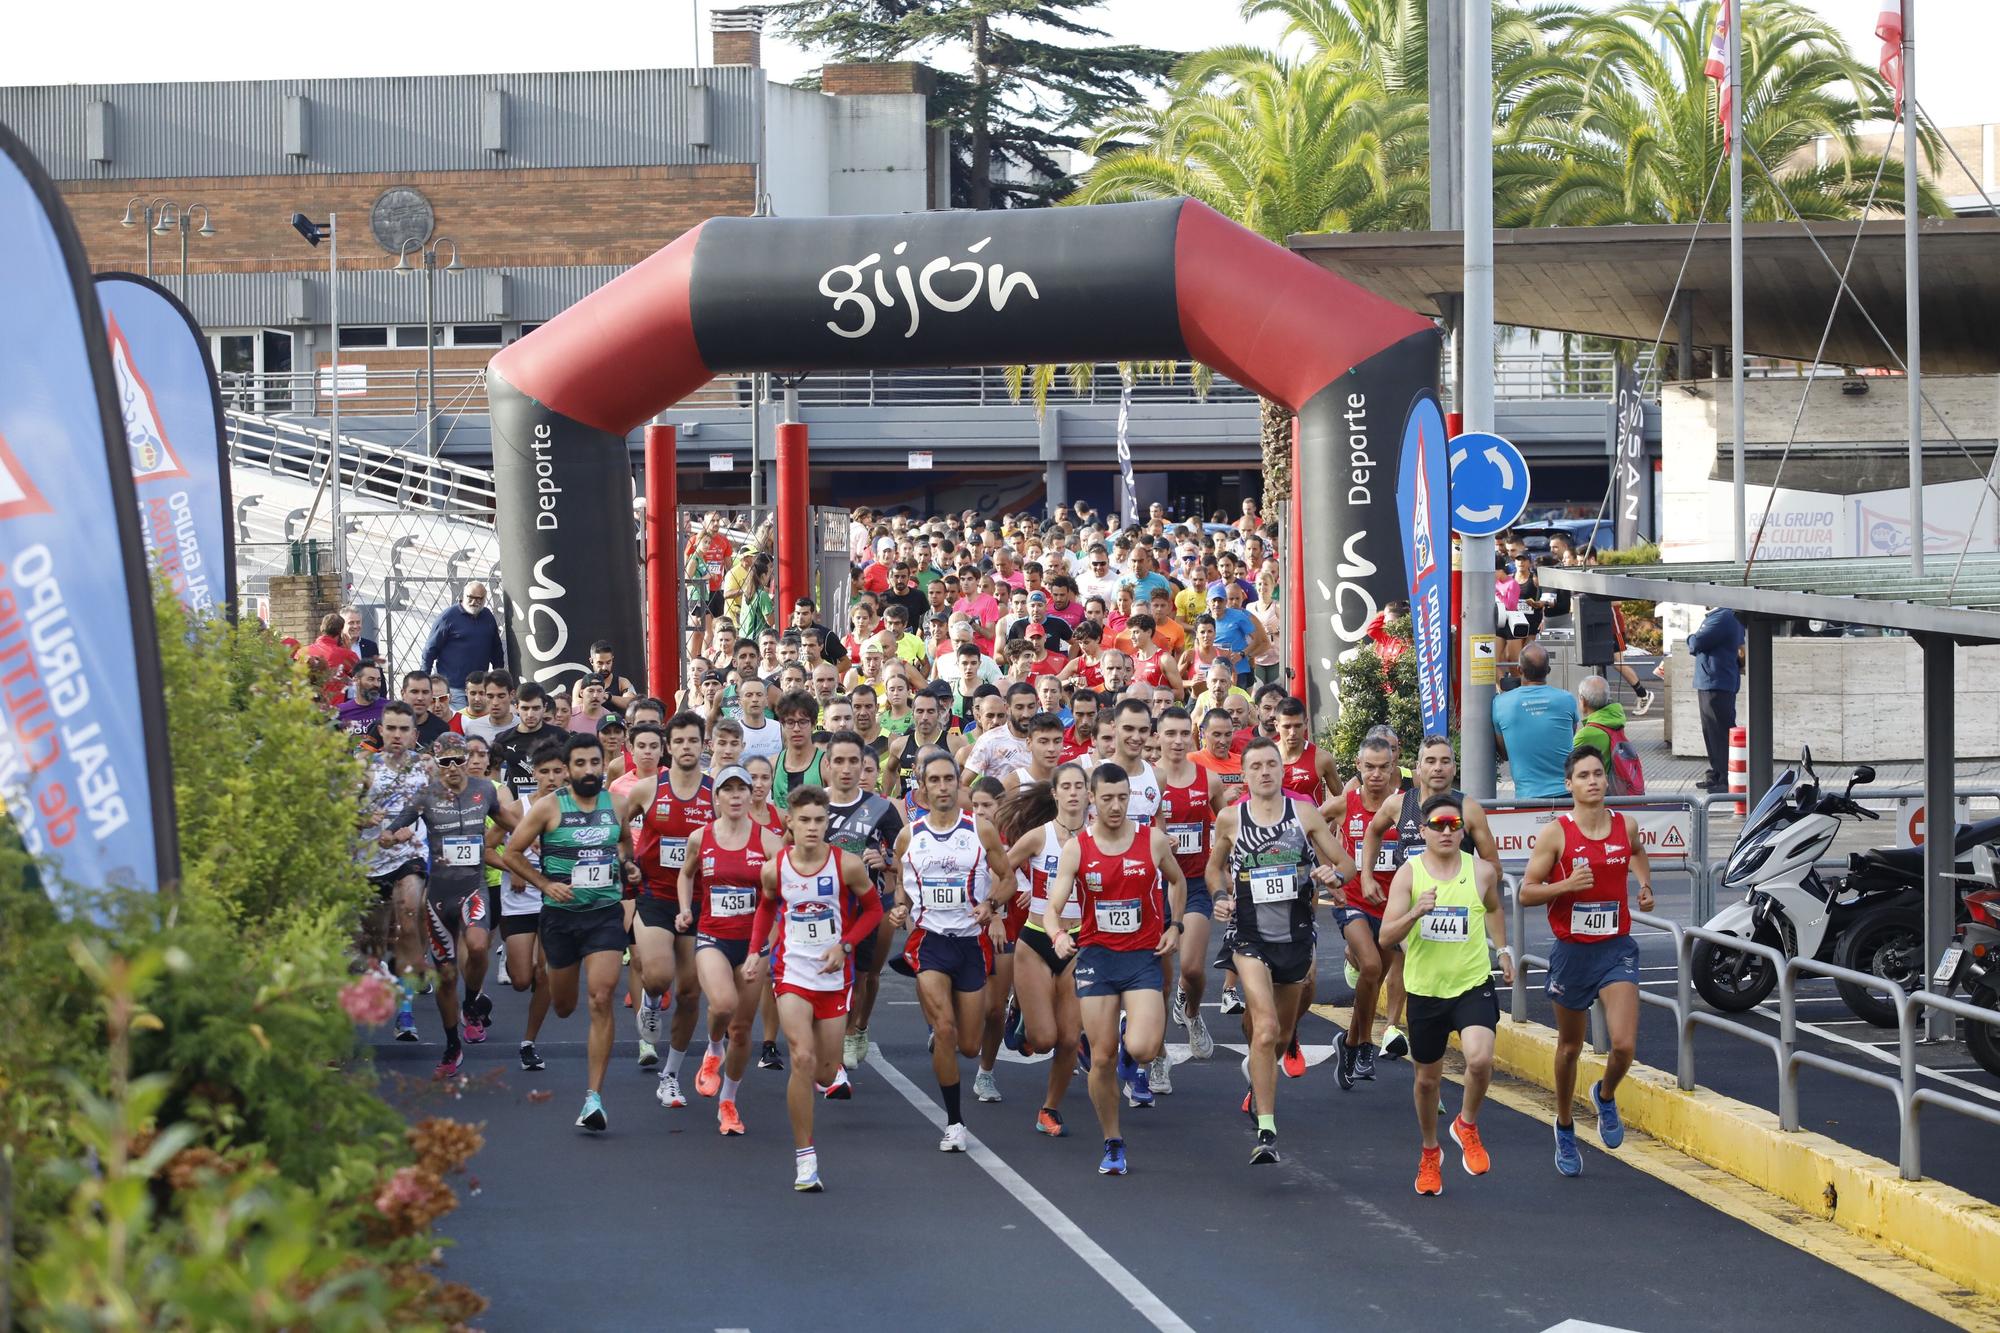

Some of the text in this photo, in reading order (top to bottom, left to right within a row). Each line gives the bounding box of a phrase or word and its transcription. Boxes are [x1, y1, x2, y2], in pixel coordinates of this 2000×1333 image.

[1343, 393, 1377, 505] Deporte
[531, 424, 563, 530] Deporte
[1748, 511, 1834, 527] REAL GRUPO
[1771, 528, 1833, 544] CULTURA
[456, 846, 472, 860] 23
[669, 848, 686, 862] 43
[588, 867, 600, 881] 12
[1266, 878, 1284, 895] 89
[721, 895, 745, 911] 435
[932, 888, 954, 904] 160
[1109, 911, 1130, 926] 123
[1430, 918, 1457, 934] 444
[1584, 913, 1606, 929] 401
[808, 923, 817, 938] 9
